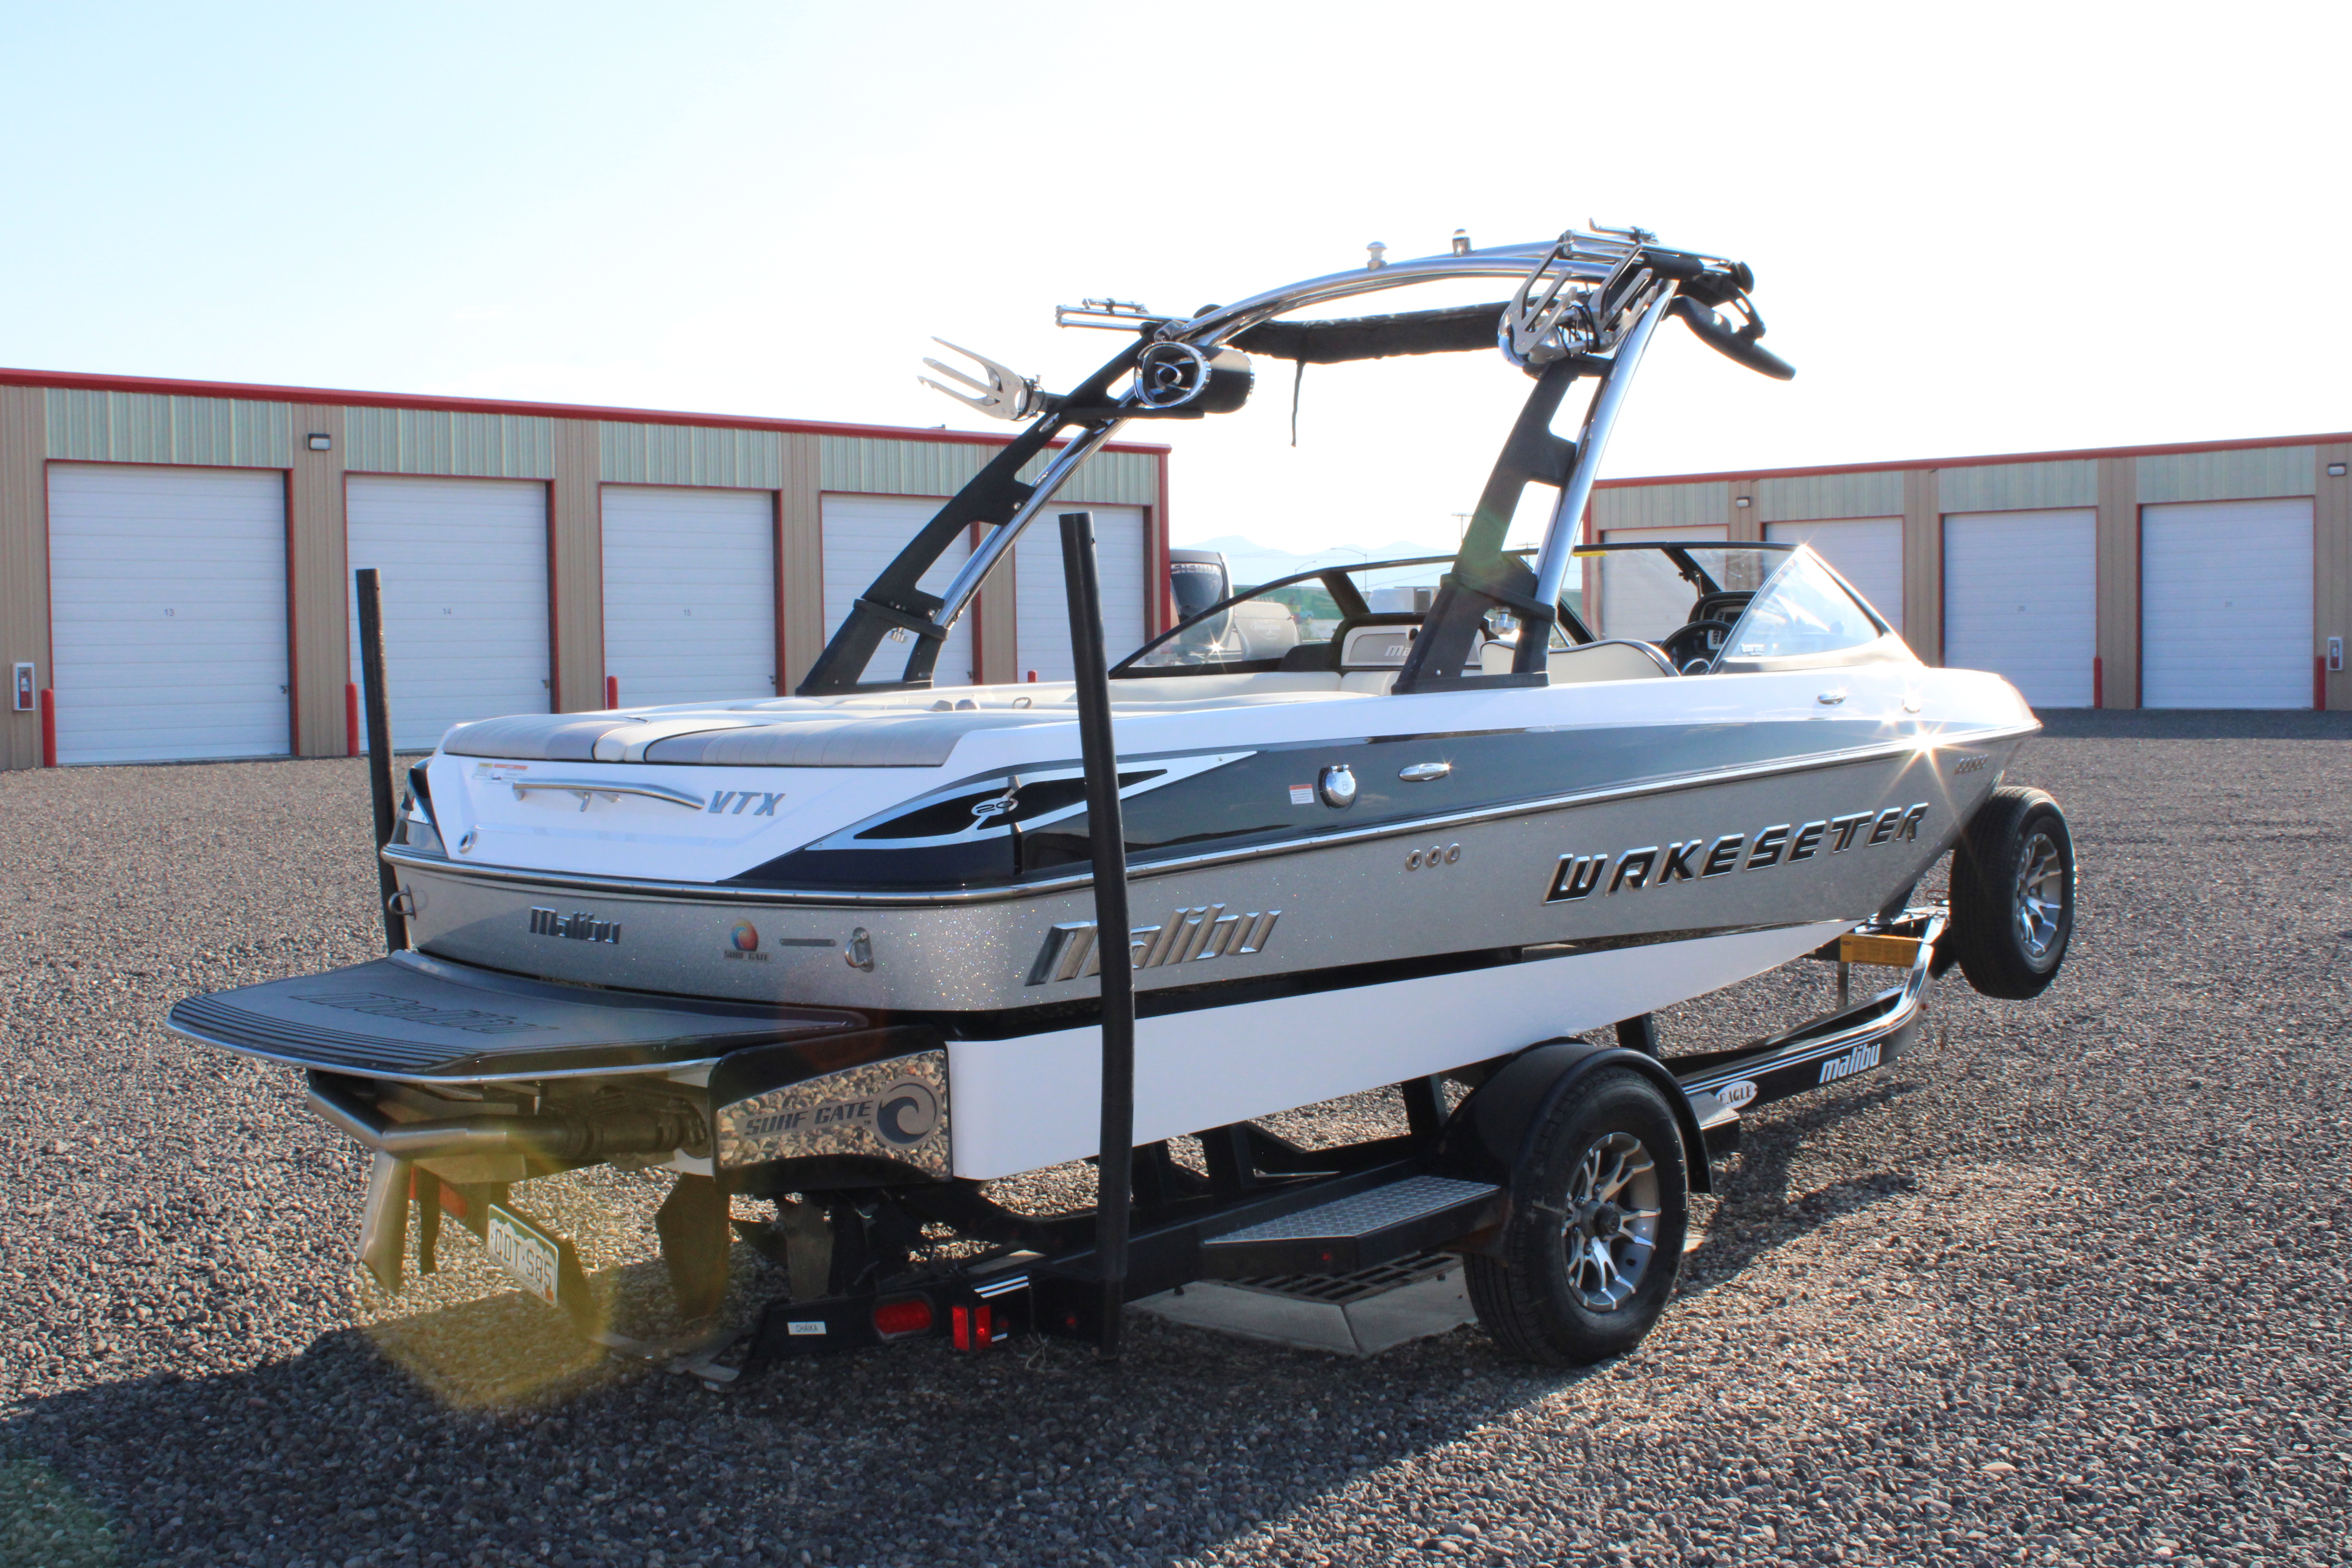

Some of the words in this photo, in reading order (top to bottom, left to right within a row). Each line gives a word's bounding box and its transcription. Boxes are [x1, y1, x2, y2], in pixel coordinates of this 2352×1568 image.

[164, 608, 175, 616] 13
[708, 790, 786, 816] VTX
[1542, 802, 1929, 906] WAKESETTER
[1719, 1085, 1752, 1105] EAGLE
[744, 1110, 809, 1136] SURF
[814, 1100, 874, 1125] GATE
